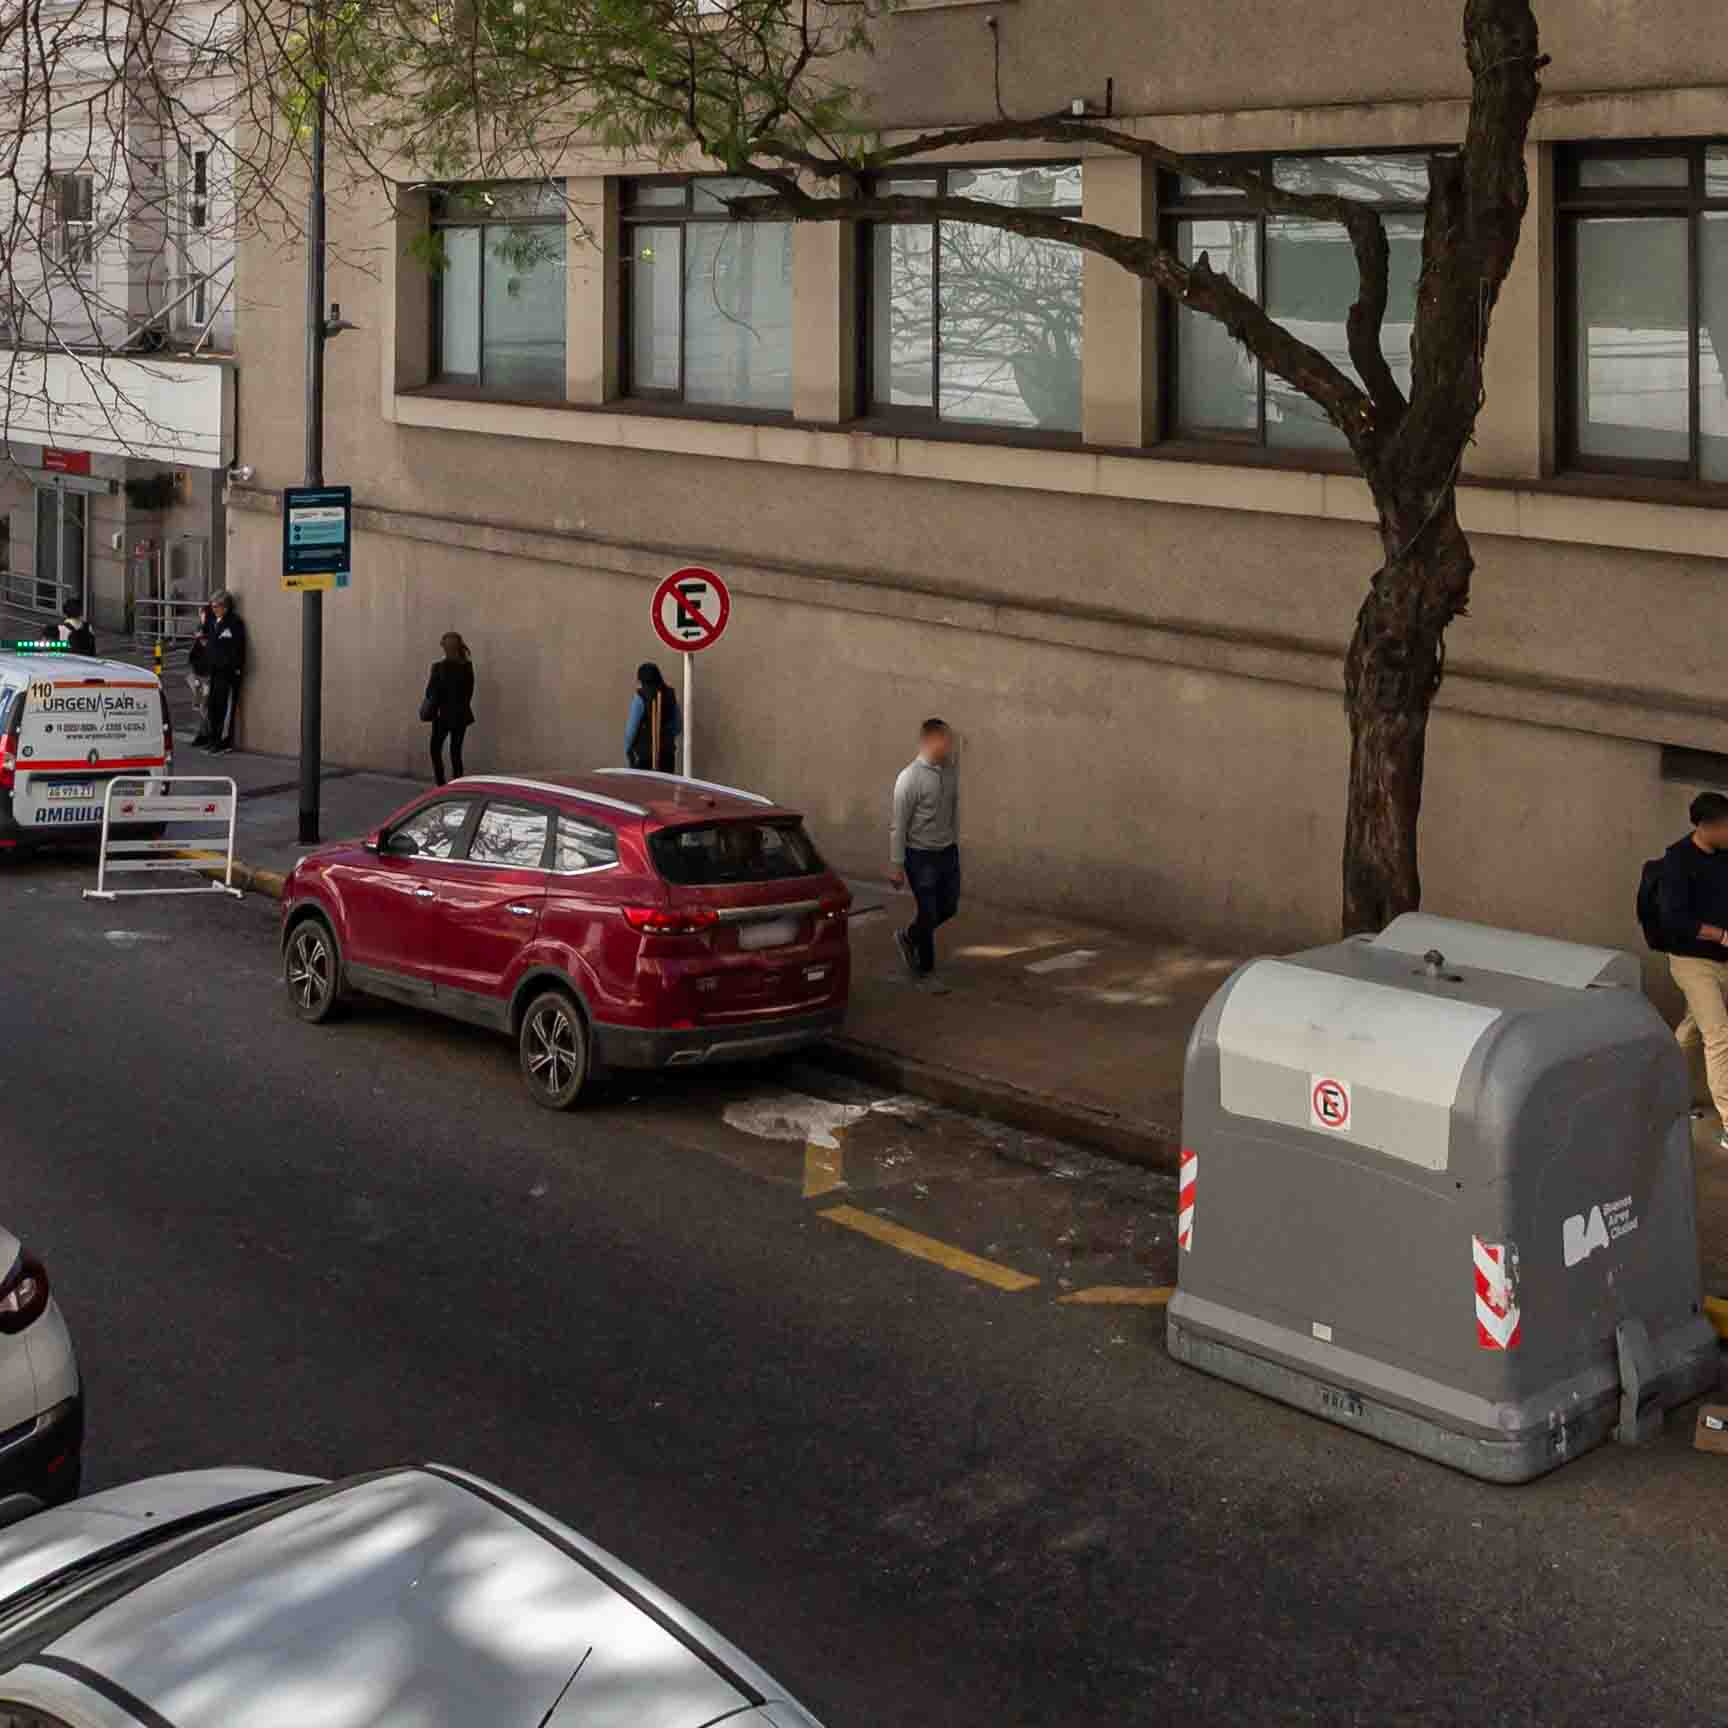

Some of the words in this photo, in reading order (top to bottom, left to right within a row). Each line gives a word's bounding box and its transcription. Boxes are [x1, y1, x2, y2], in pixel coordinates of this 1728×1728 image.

[677, 583, 707, 629] E
[32, 682, 53, 698] 110
[1323, 1088, 1339, 1118] E
[1563, 1204, 1610, 1267] BA
